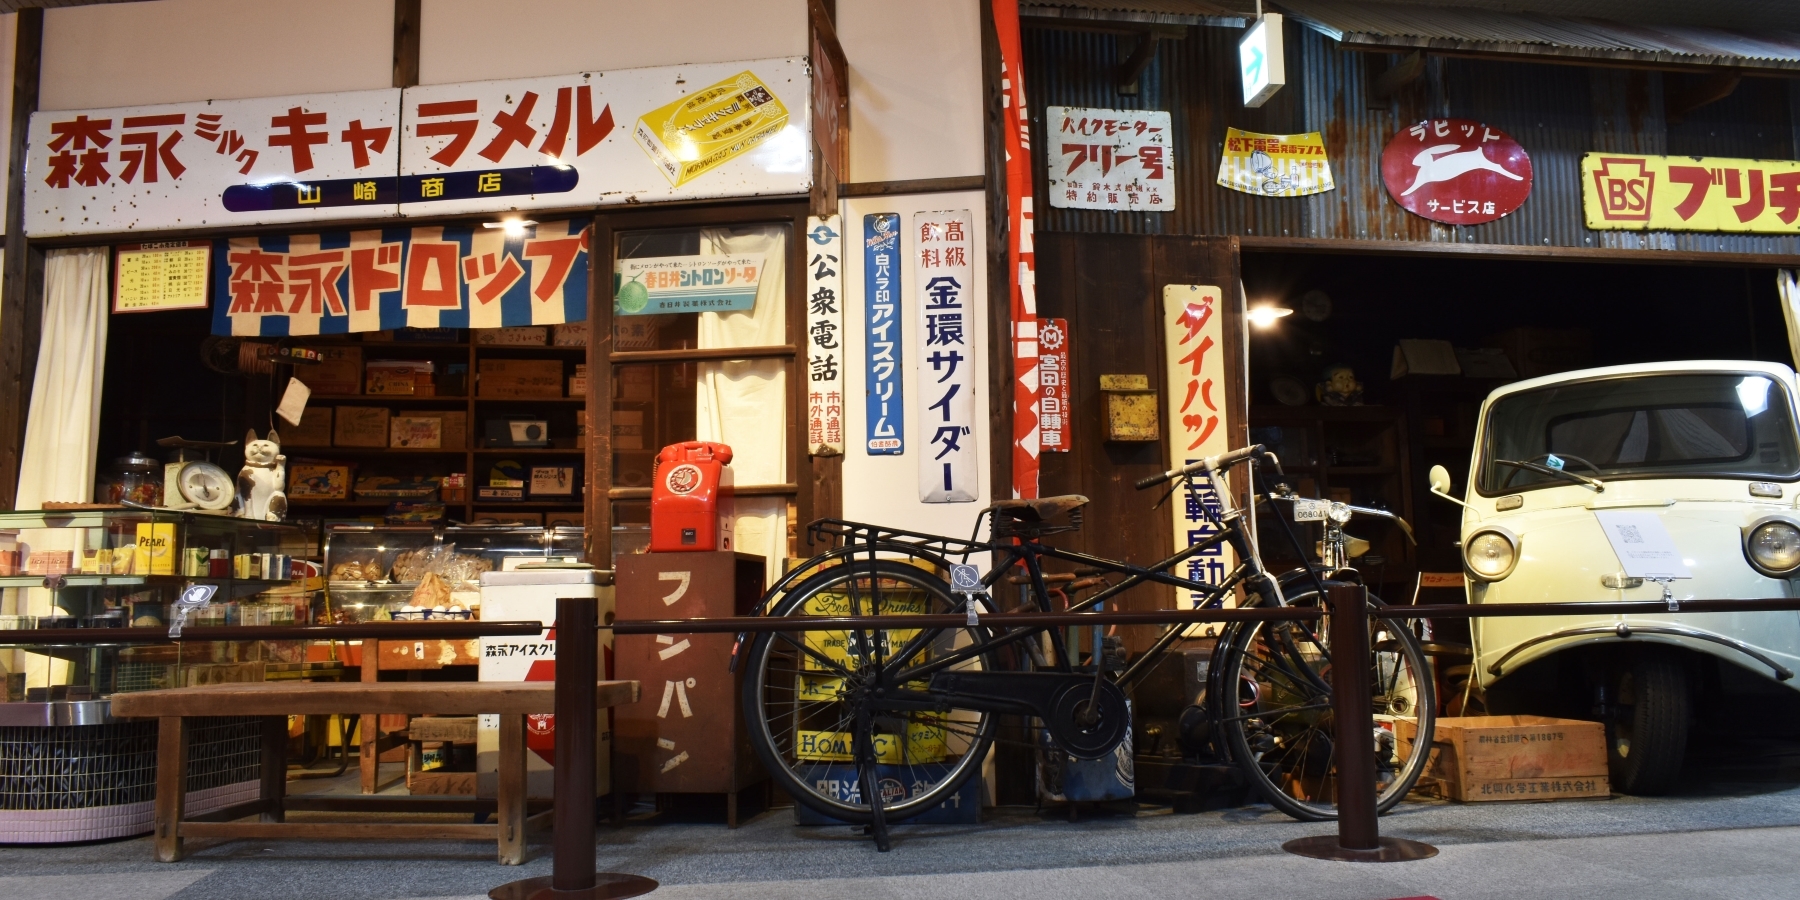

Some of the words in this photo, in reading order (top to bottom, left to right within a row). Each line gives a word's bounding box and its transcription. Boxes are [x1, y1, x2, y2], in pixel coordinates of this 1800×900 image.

[1062, 117, 1163, 137] バイクモーター
[1409, 120, 1500, 143] ラビット
[1062, 143, 1163, 180] フリー号
[297, 172, 502, 205] 山崎商店
[1066, 189, 1161, 205] 特約販売店
[1426, 199, 1496, 215] サービス店
[1608, 178, 1648, 211] BS
[919, 222, 942, 269] 飲料
[228, 232, 590, 316] 森永ドロップ
[875, 253, 890, 302] 白バラ印
[809, 253, 839, 382] 公衆電話
[872, 303, 896, 437] アイスクリーム
[925, 276, 971, 492] 金環サイダー
[1175, 296, 1220, 451] ダイハツ
[809, 391, 824, 444] 市外通話
[826, 391, 841, 443] 市内通話
[139, 536, 166, 547] PEARL
